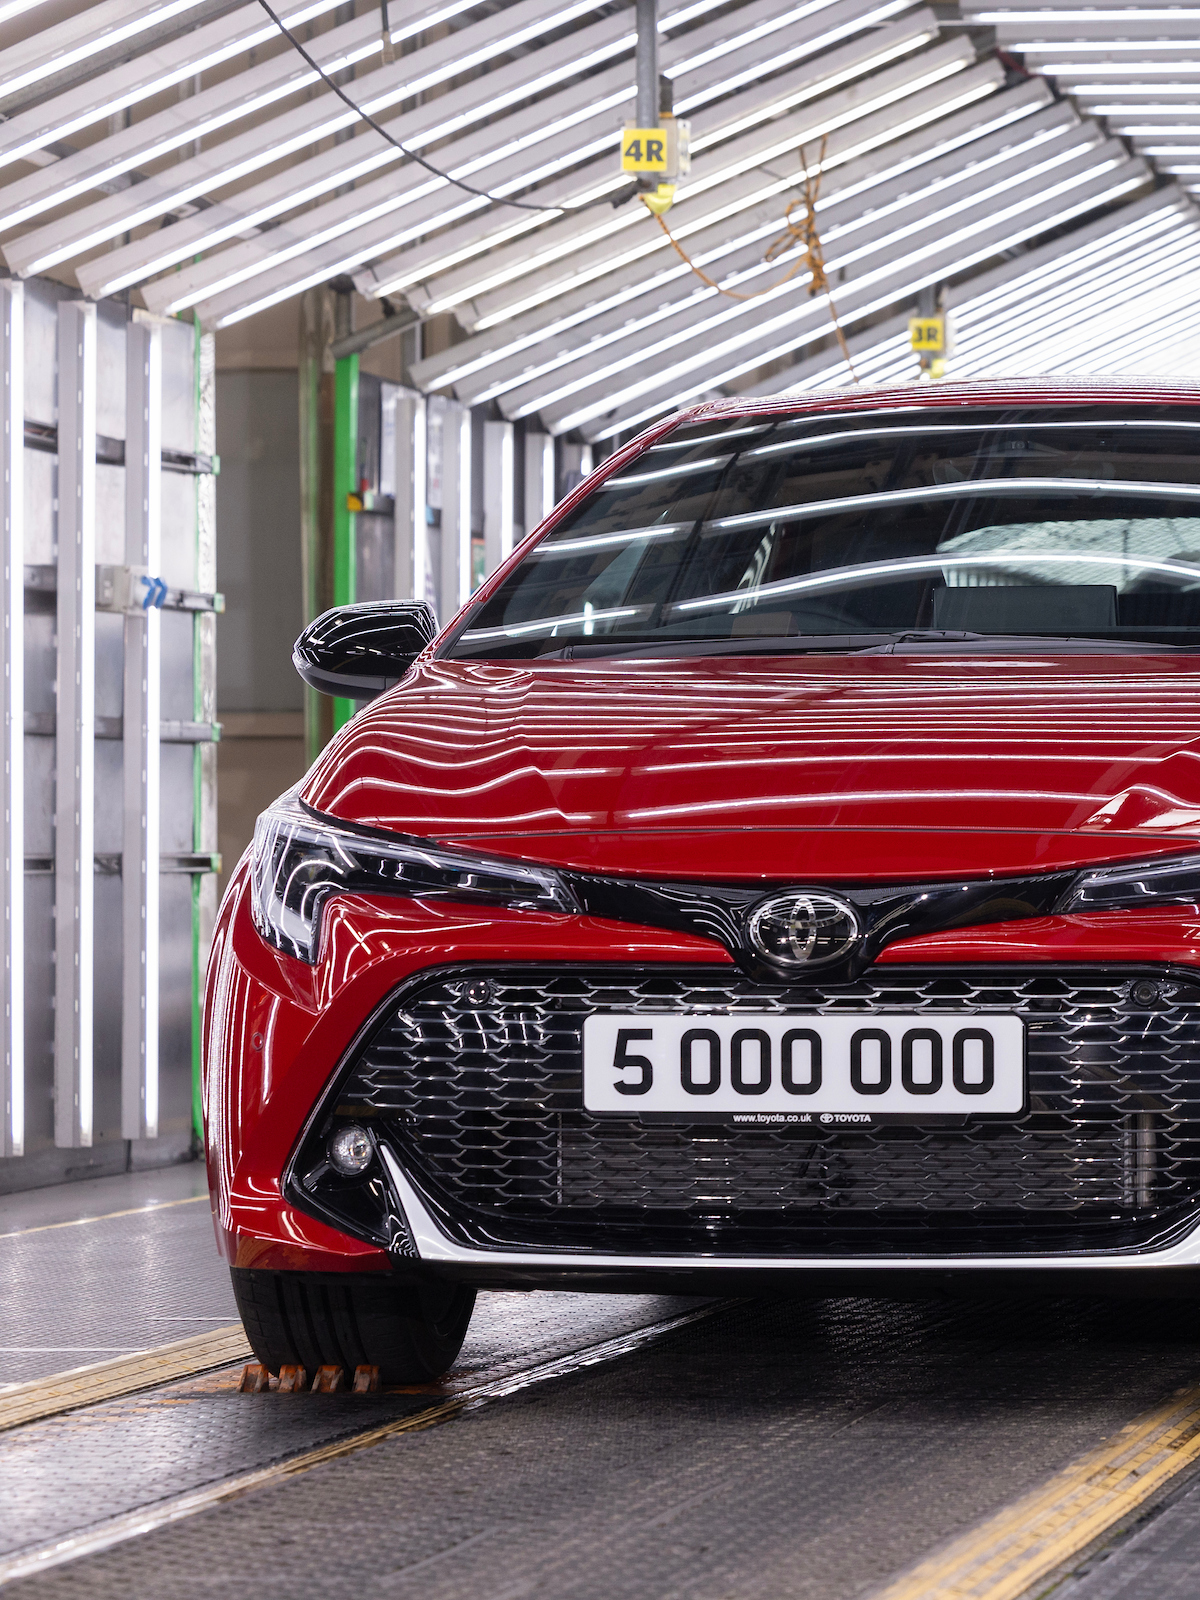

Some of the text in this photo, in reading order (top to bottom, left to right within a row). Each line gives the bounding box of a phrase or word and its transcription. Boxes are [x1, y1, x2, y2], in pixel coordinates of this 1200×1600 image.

[624, 139, 664, 162] 4R
[612, 1028, 994, 1096] 5 000 000
[733, 1113, 872, 1124] www.toyota.co.uk TOYOTA
